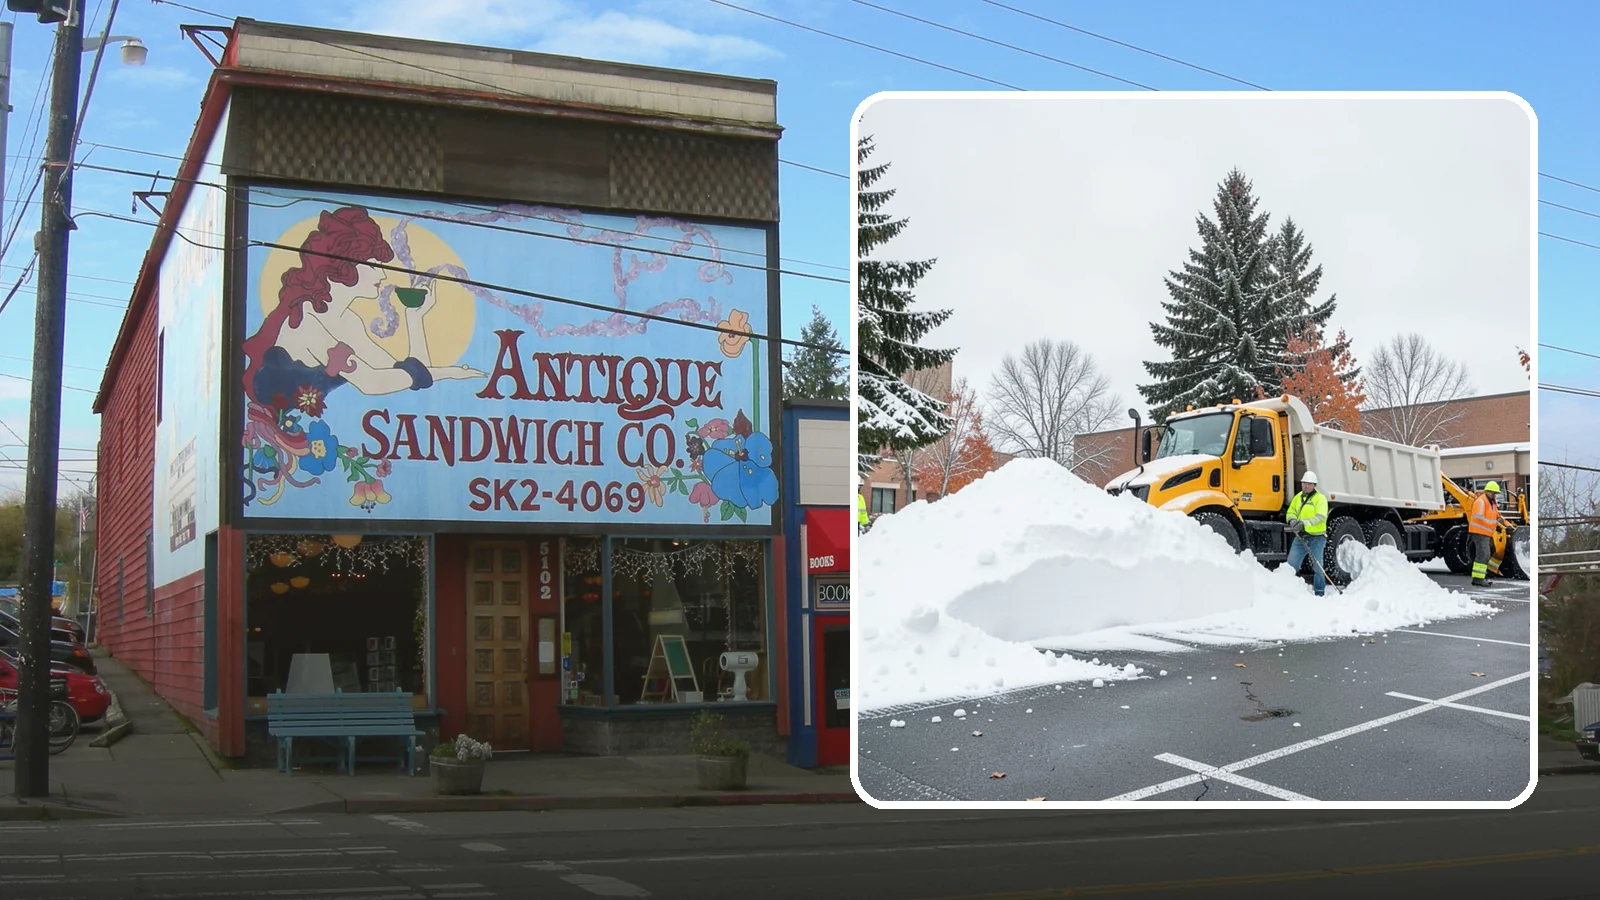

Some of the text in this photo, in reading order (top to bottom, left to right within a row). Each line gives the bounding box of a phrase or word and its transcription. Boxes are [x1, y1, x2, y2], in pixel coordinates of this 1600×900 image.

[476, 330, 723, 421] ANTIQUE
[361, 410, 685, 467] SANDWICH CO.
[469, 480, 645, 512] SK2-4069
[539, 541, 552, 599] 5102
[810, 556, 834, 569] BOOKS
